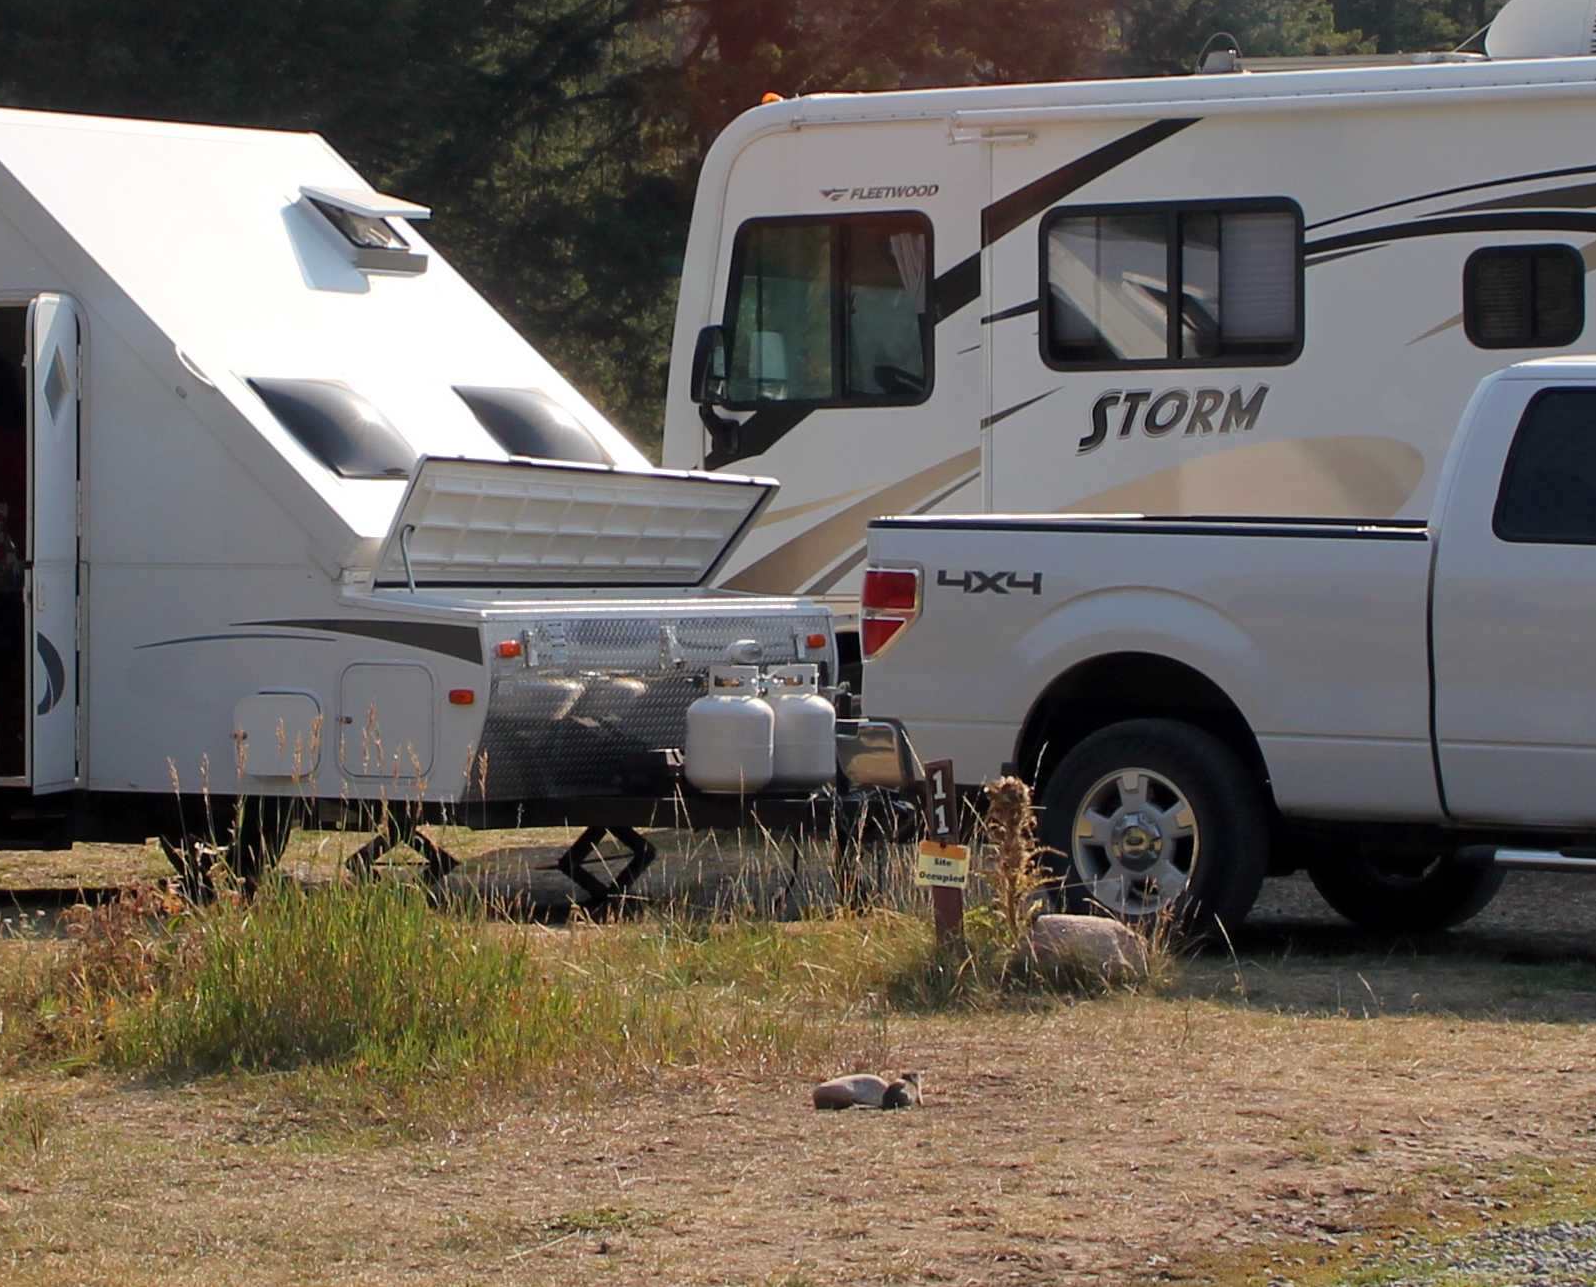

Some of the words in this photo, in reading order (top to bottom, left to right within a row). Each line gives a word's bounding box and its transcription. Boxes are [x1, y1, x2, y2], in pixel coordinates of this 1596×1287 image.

[849, 184, 940, 201] FLEETWOOD
[1076, 382, 1271, 456] STORM
[934, 856, 952, 867] Site
[918, 870, 965, 884] Occupied
